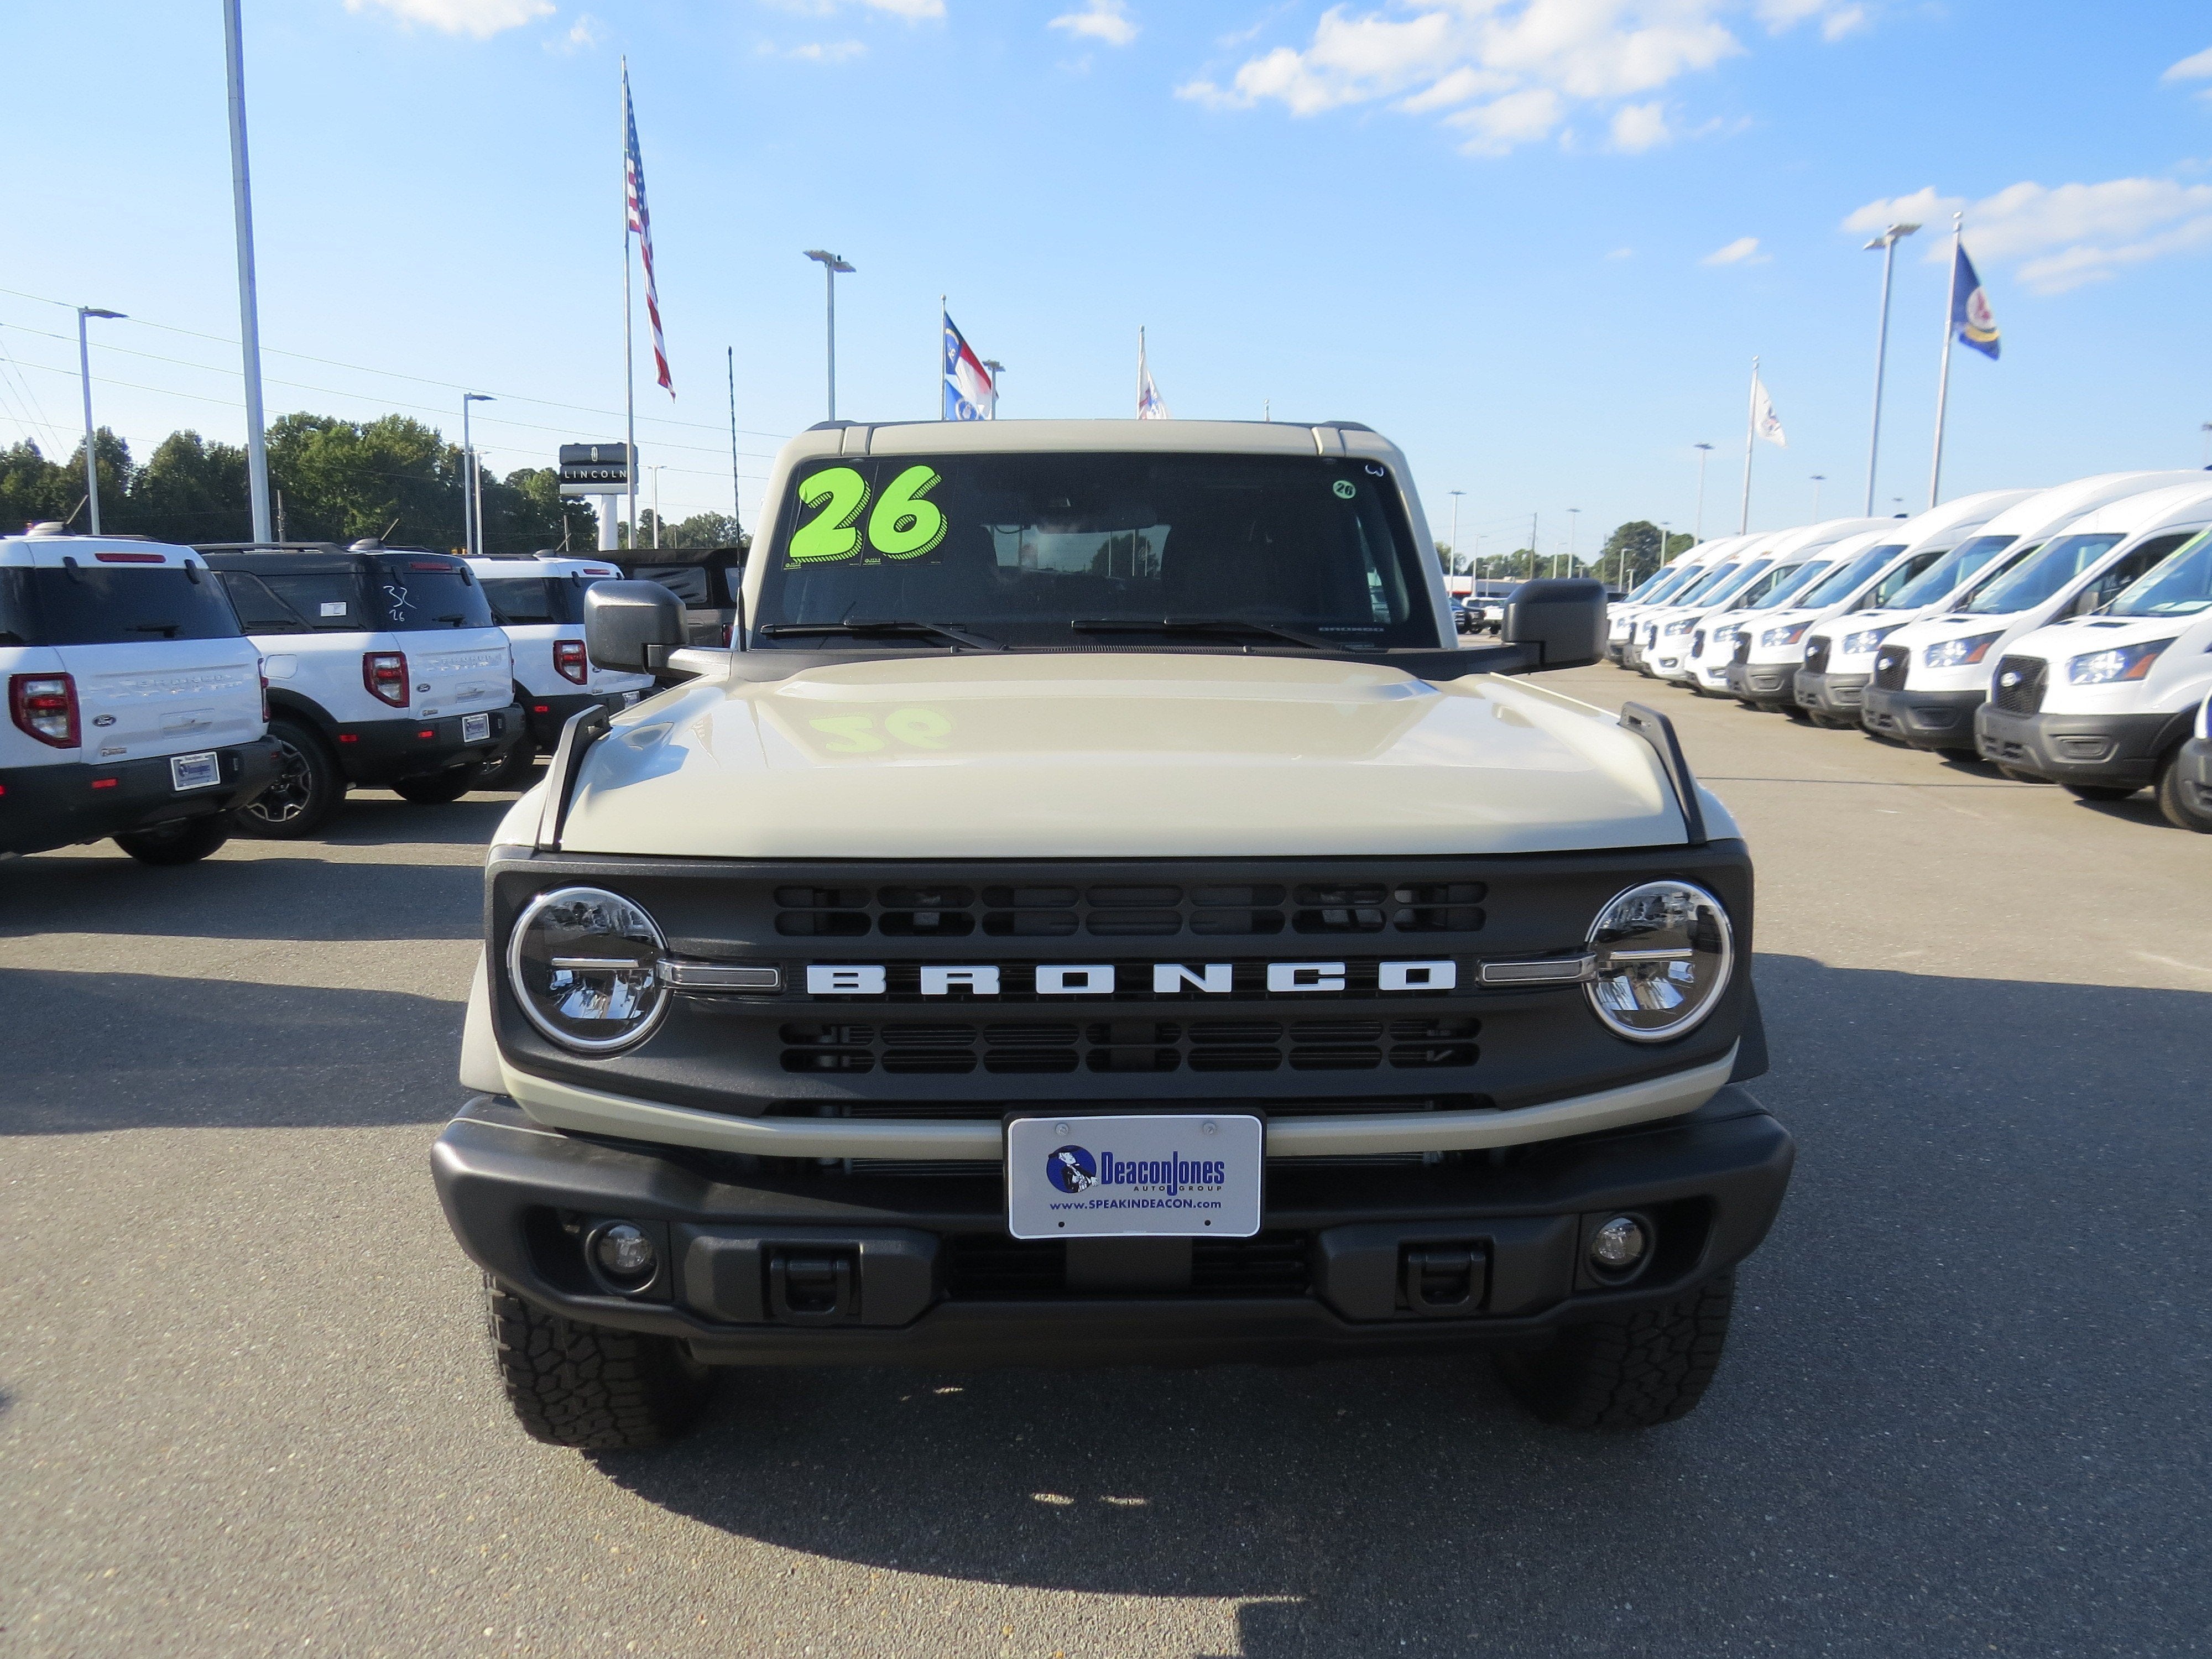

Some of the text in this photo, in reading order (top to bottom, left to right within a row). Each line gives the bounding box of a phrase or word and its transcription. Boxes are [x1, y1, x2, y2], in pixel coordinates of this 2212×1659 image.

[564, 470, 627, 479] LINCOLN
[1335, 483, 1354, 495] 26
[789, 465, 948, 563] 26
[389, 609, 405, 622] 26
[806, 961, 1457, 995] BRONCO
[1050, 1198, 1222, 1210] www.SPEAKINDEACON.com
